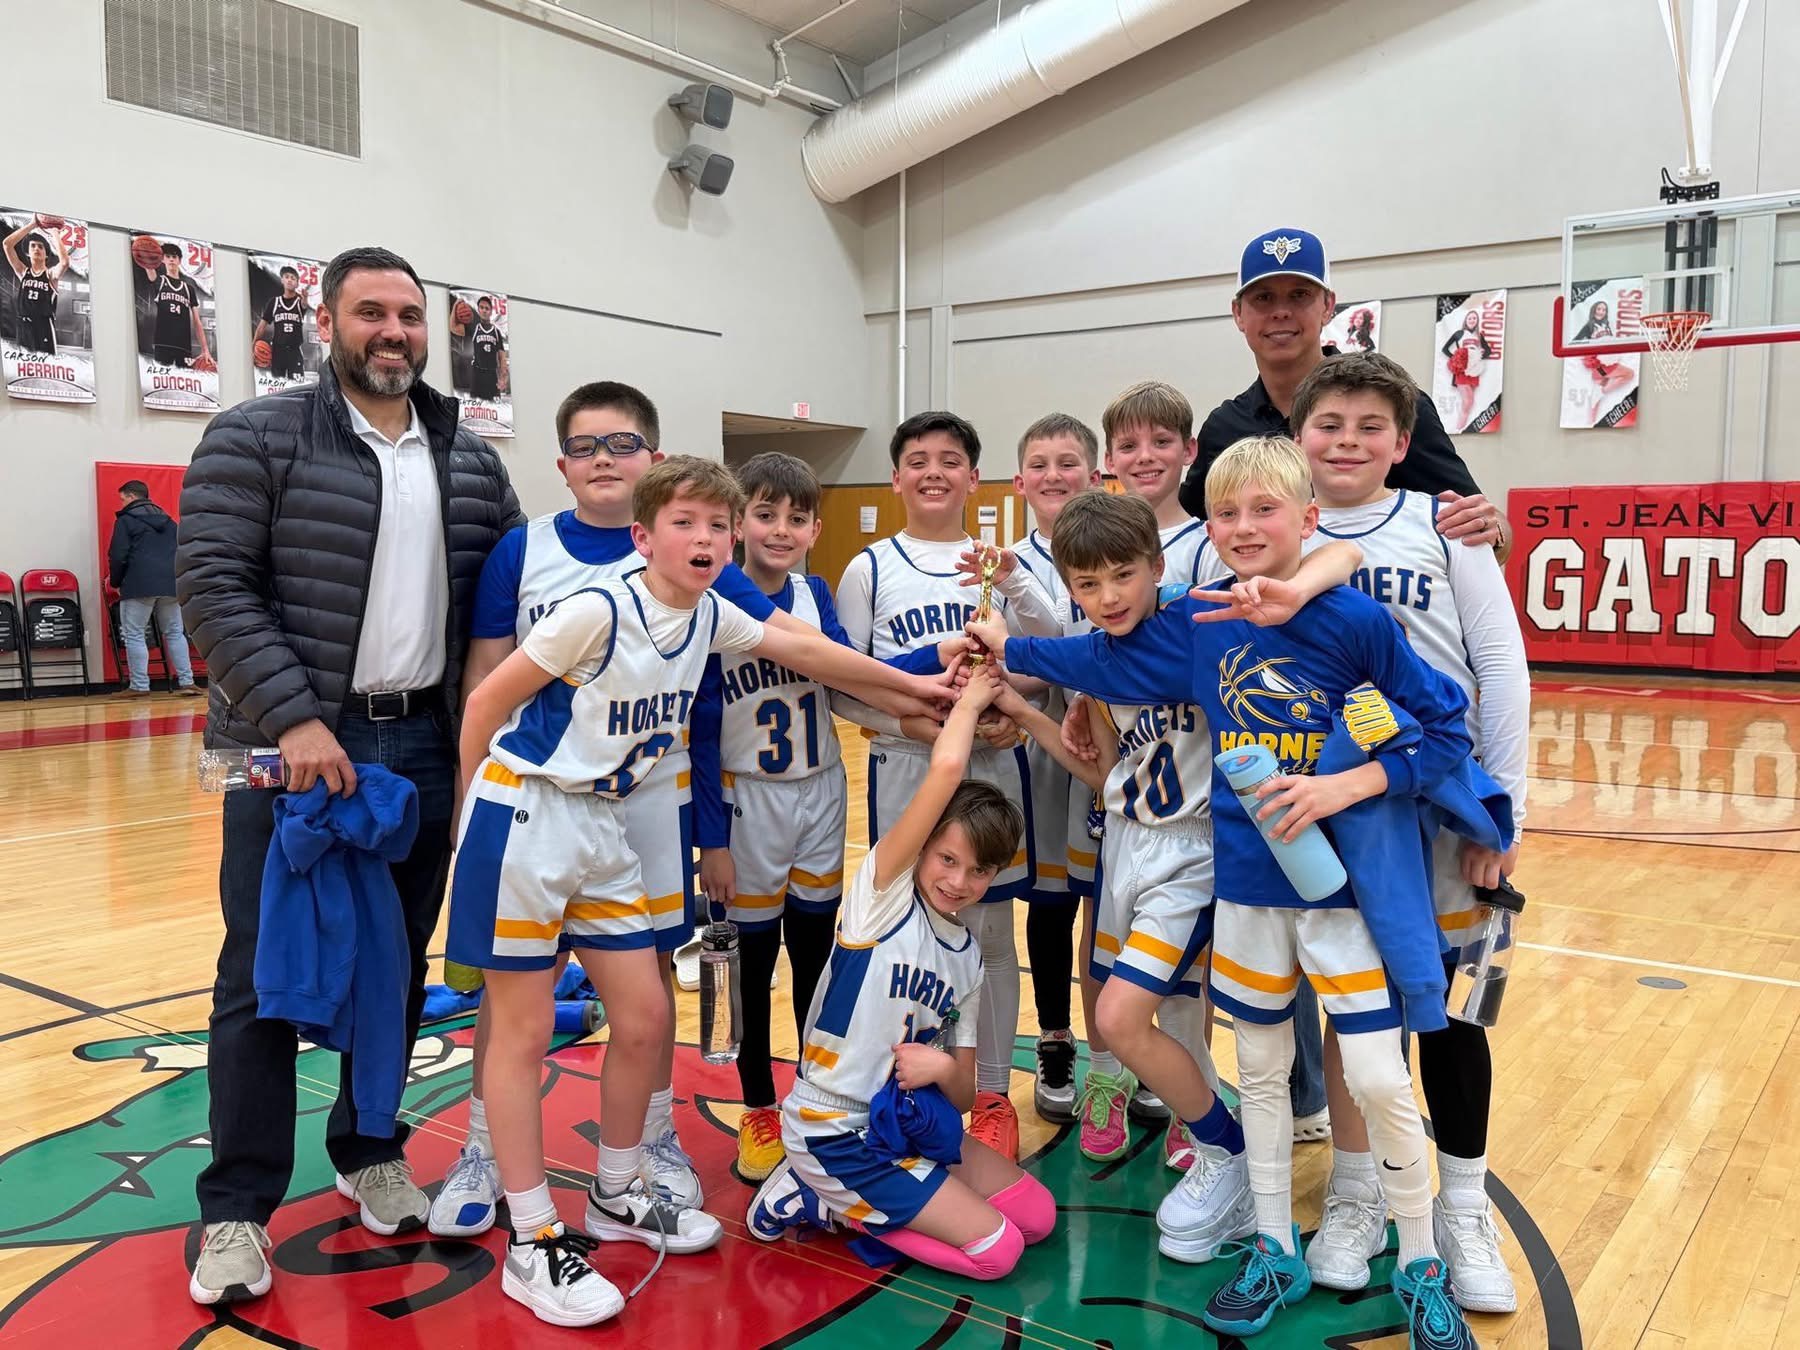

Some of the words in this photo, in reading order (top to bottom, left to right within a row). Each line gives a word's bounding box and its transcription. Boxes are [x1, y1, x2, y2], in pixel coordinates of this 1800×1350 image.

[27, 289, 39, 300] 23
[170, 303, 181, 315] 24
[4, 351, 49, 364] CARSON
[17, 362, 76, 382] HERRING
[147, 366, 172, 376] ALEX
[153, 376, 202, 393] DUNCAN
[464, 407, 498, 421] DOMINO
[1476, 406, 1498, 429] CHEER
[1608, 401, 1633, 425] CHEER
[1527, 504, 1590, 529] ST.
[1606, 503, 1726, 528] JEAN
[754, 690, 820, 776] 31
